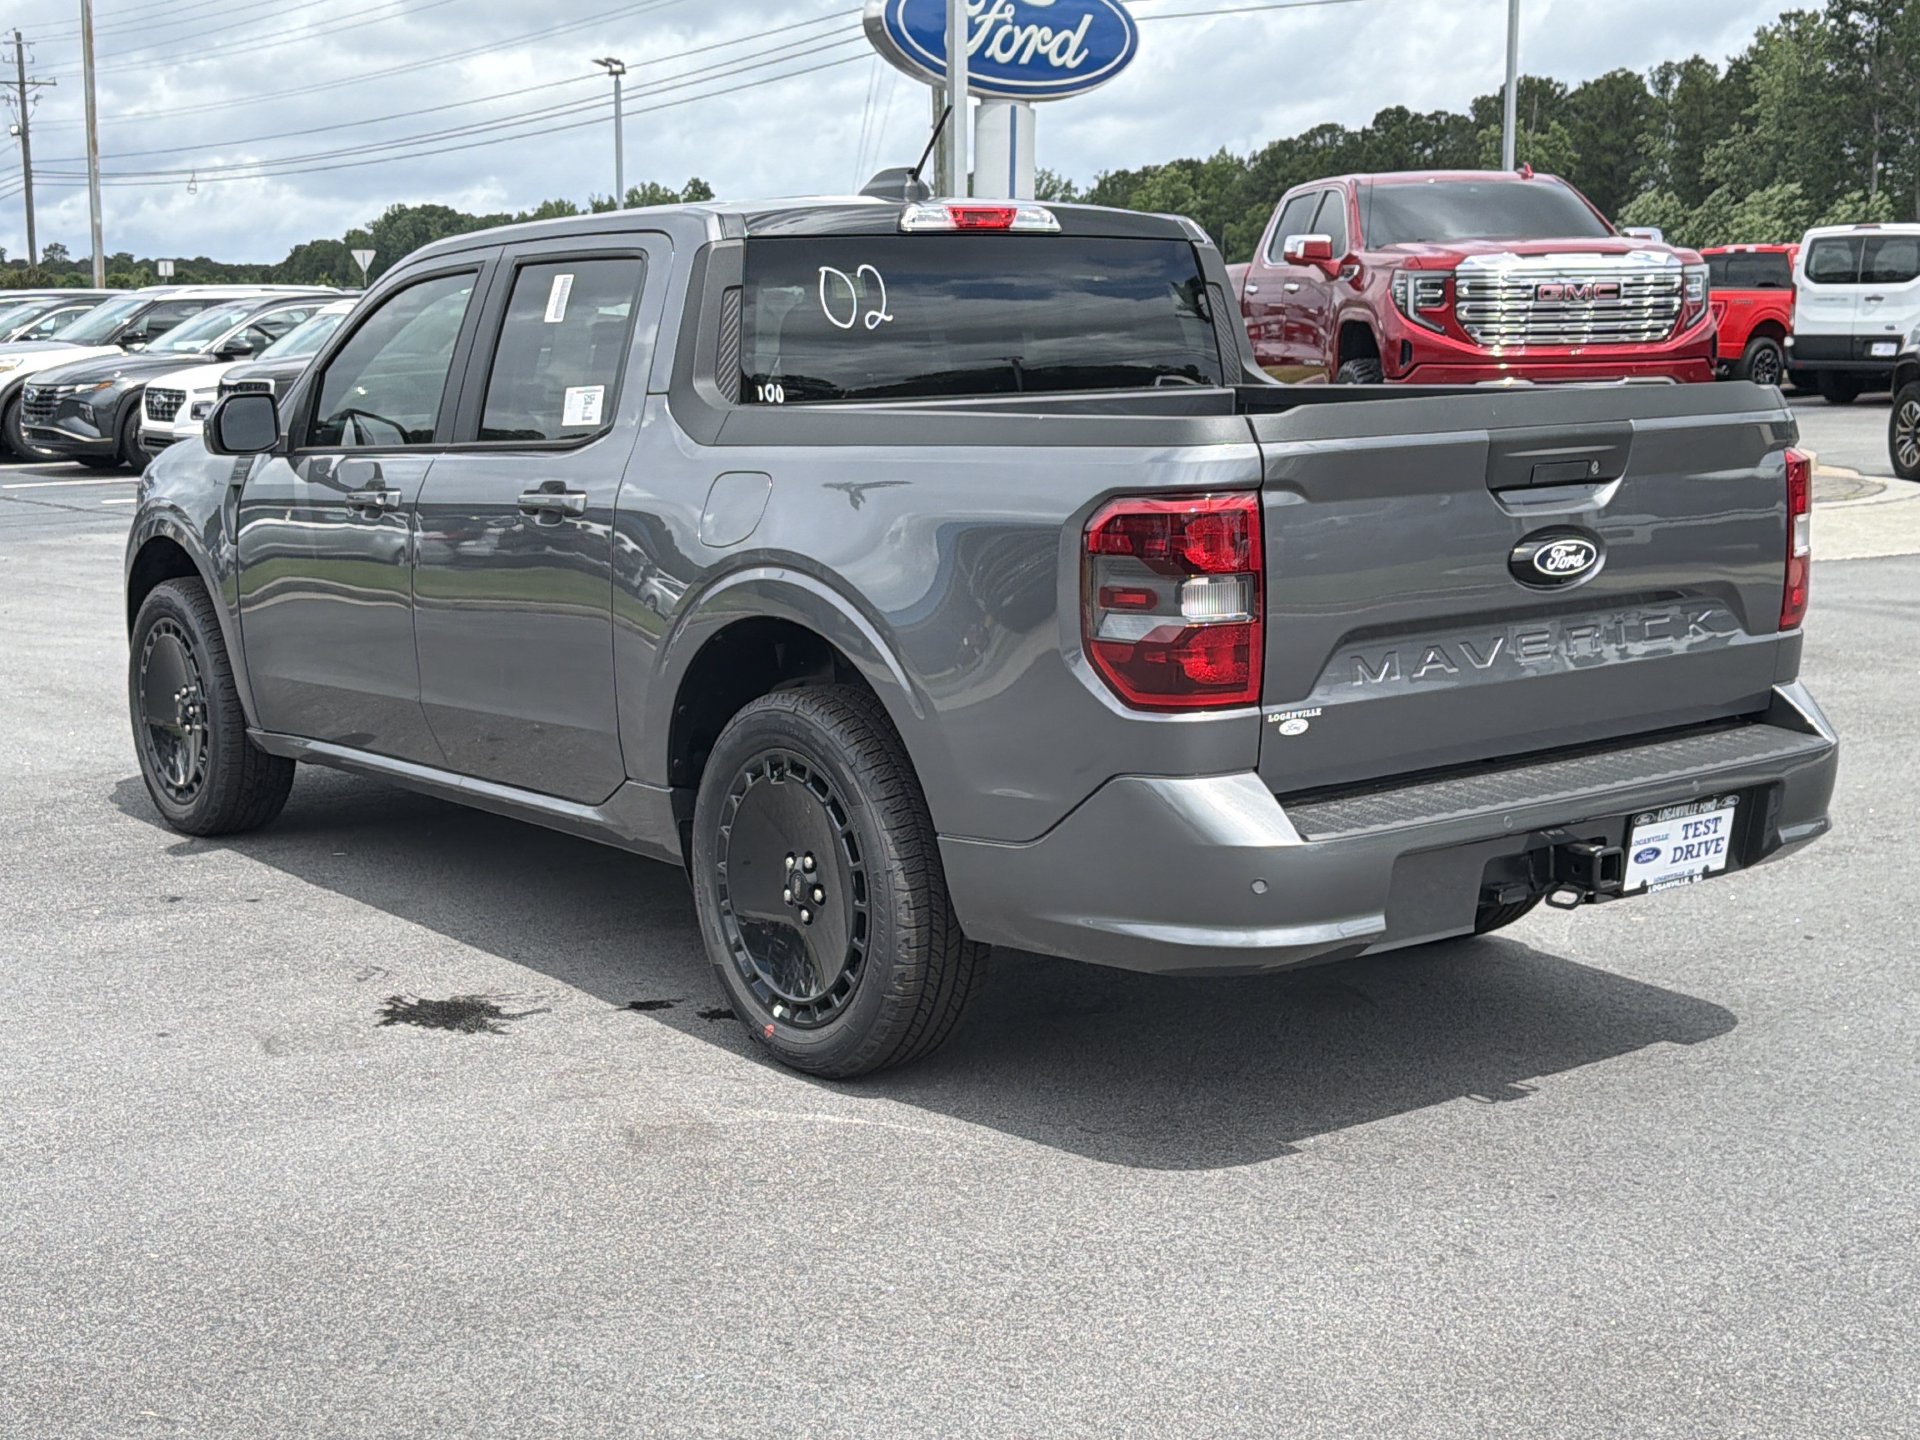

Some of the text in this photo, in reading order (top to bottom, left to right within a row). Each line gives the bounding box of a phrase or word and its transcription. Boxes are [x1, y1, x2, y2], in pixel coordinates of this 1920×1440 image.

[944, 0, 1094, 69] Ford
[1537, 283, 1619, 300] GMC
[757, 383, 785, 403] 100
[1546, 545, 1586, 570] Ford
[1350, 609, 1714, 687] MAVERICK
[1268, 707, 1322, 722] LOGANVILLE
[1682, 815, 1722, 841] TEST
[1669, 836, 1725, 864] DRIVE
